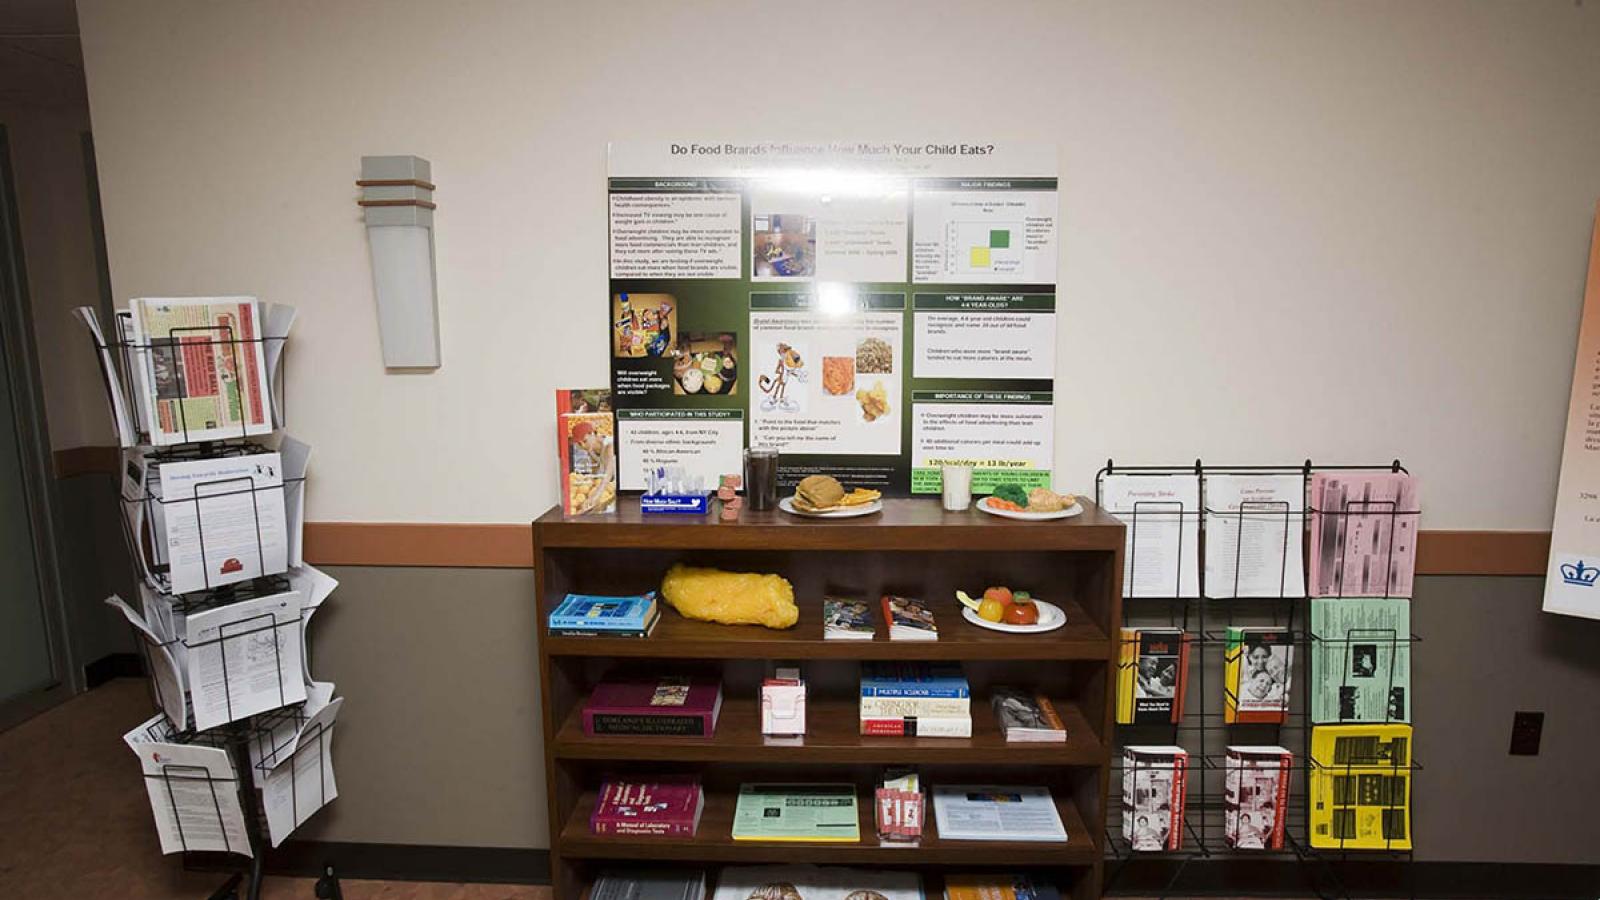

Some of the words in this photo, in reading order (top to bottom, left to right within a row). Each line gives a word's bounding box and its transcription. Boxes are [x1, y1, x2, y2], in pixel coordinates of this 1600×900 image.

[671, 144, 688, 155] Do
[691, 144, 721, 155] Food
[724, 144, 766, 155] Brands
[858, 144, 890, 155] Much
[894, 144, 922, 155] Your
[925, 144, 957, 155] Child
[960, 144, 995, 155] Eats?
